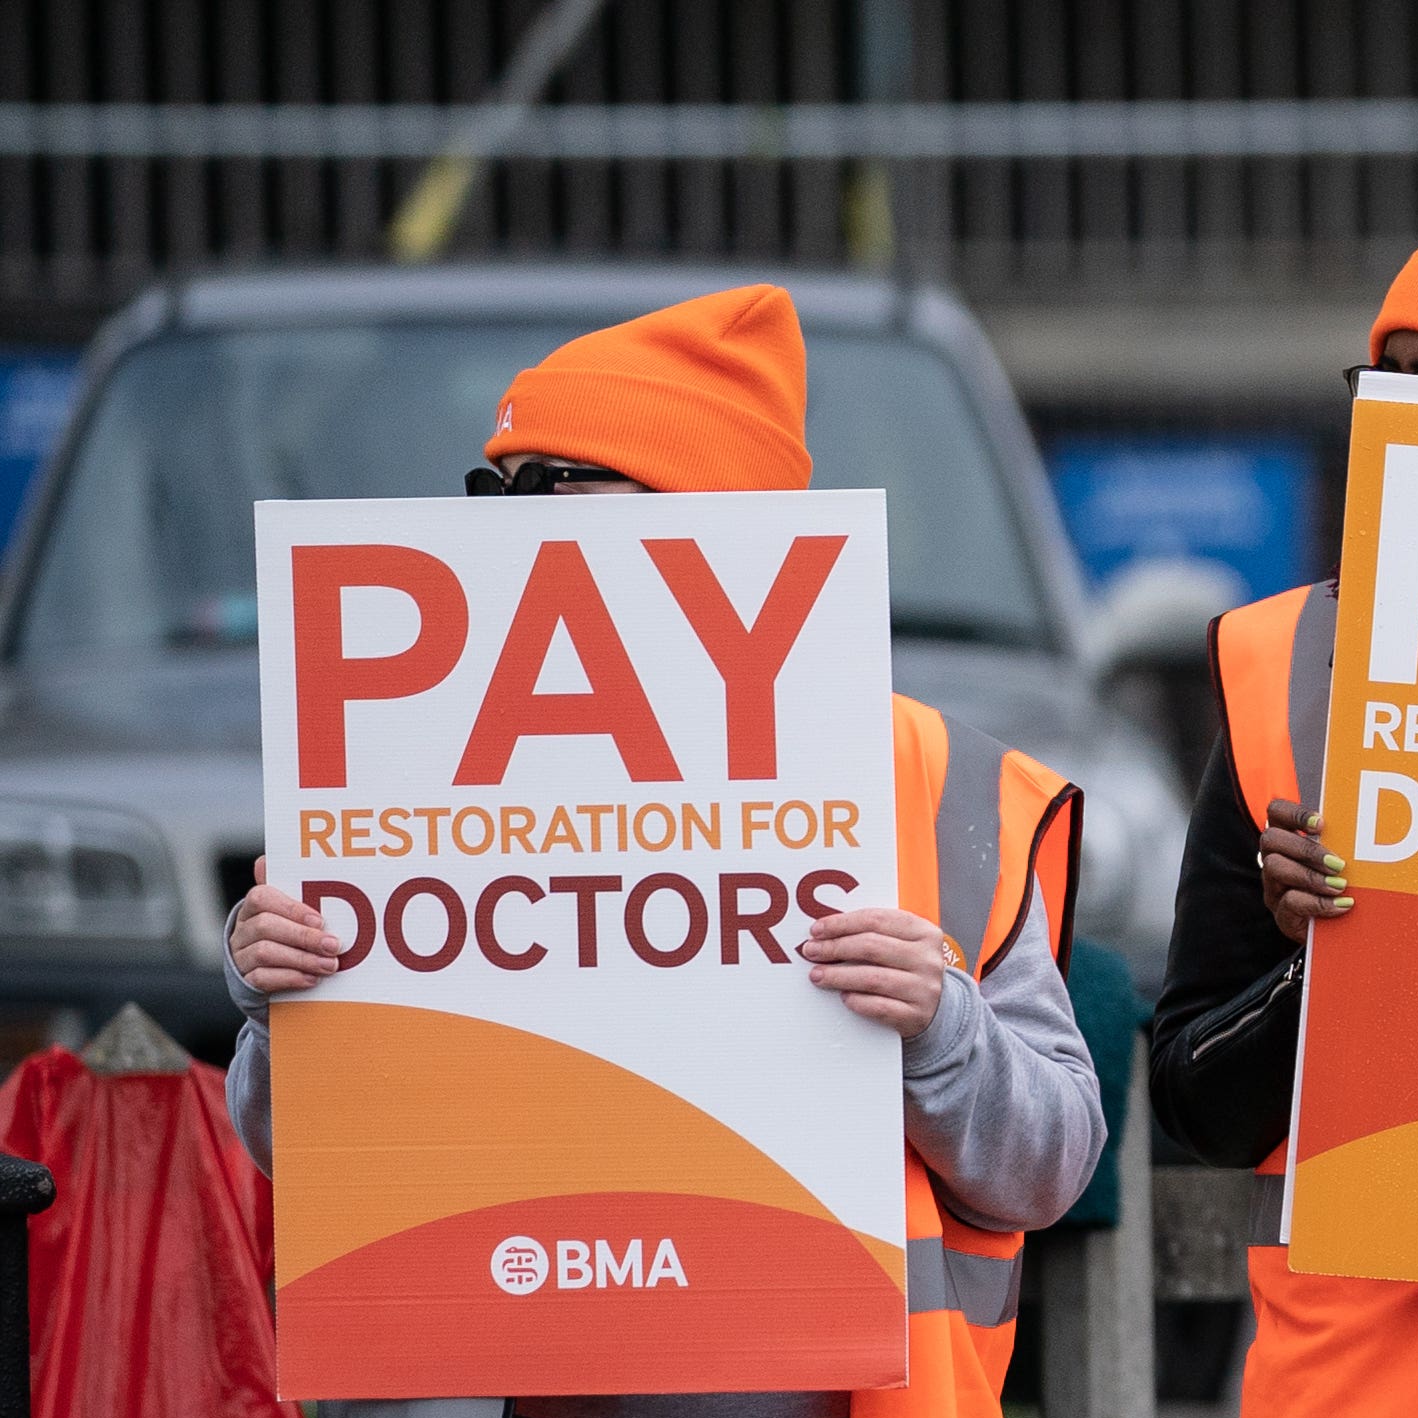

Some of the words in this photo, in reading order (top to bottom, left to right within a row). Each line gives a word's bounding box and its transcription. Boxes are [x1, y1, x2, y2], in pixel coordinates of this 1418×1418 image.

[291, 534, 849, 789] PAY
[299, 802, 721, 858] RESTORATION
[741, 799, 860, 849] FOR
[556, 1237, 689, 1289] BMA
